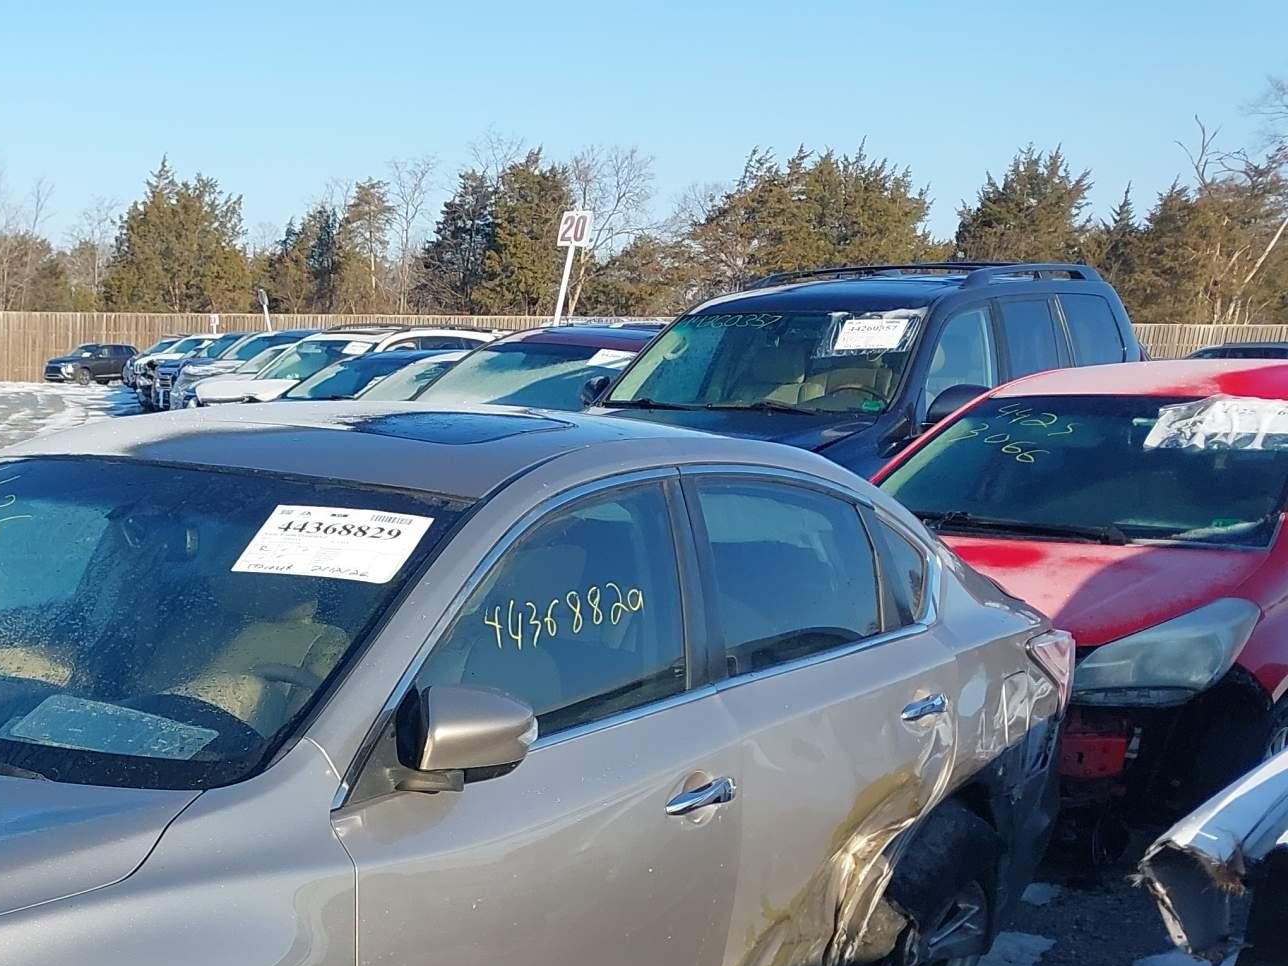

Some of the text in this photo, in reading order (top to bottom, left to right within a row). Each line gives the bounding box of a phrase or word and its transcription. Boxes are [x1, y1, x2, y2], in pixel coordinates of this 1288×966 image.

[560, 215, 588, 242] 20
[948, 423, 1052, 464] 3066
[277, 520, 402, 541] 44368829
[484, 582, 645, 650] 44368829
